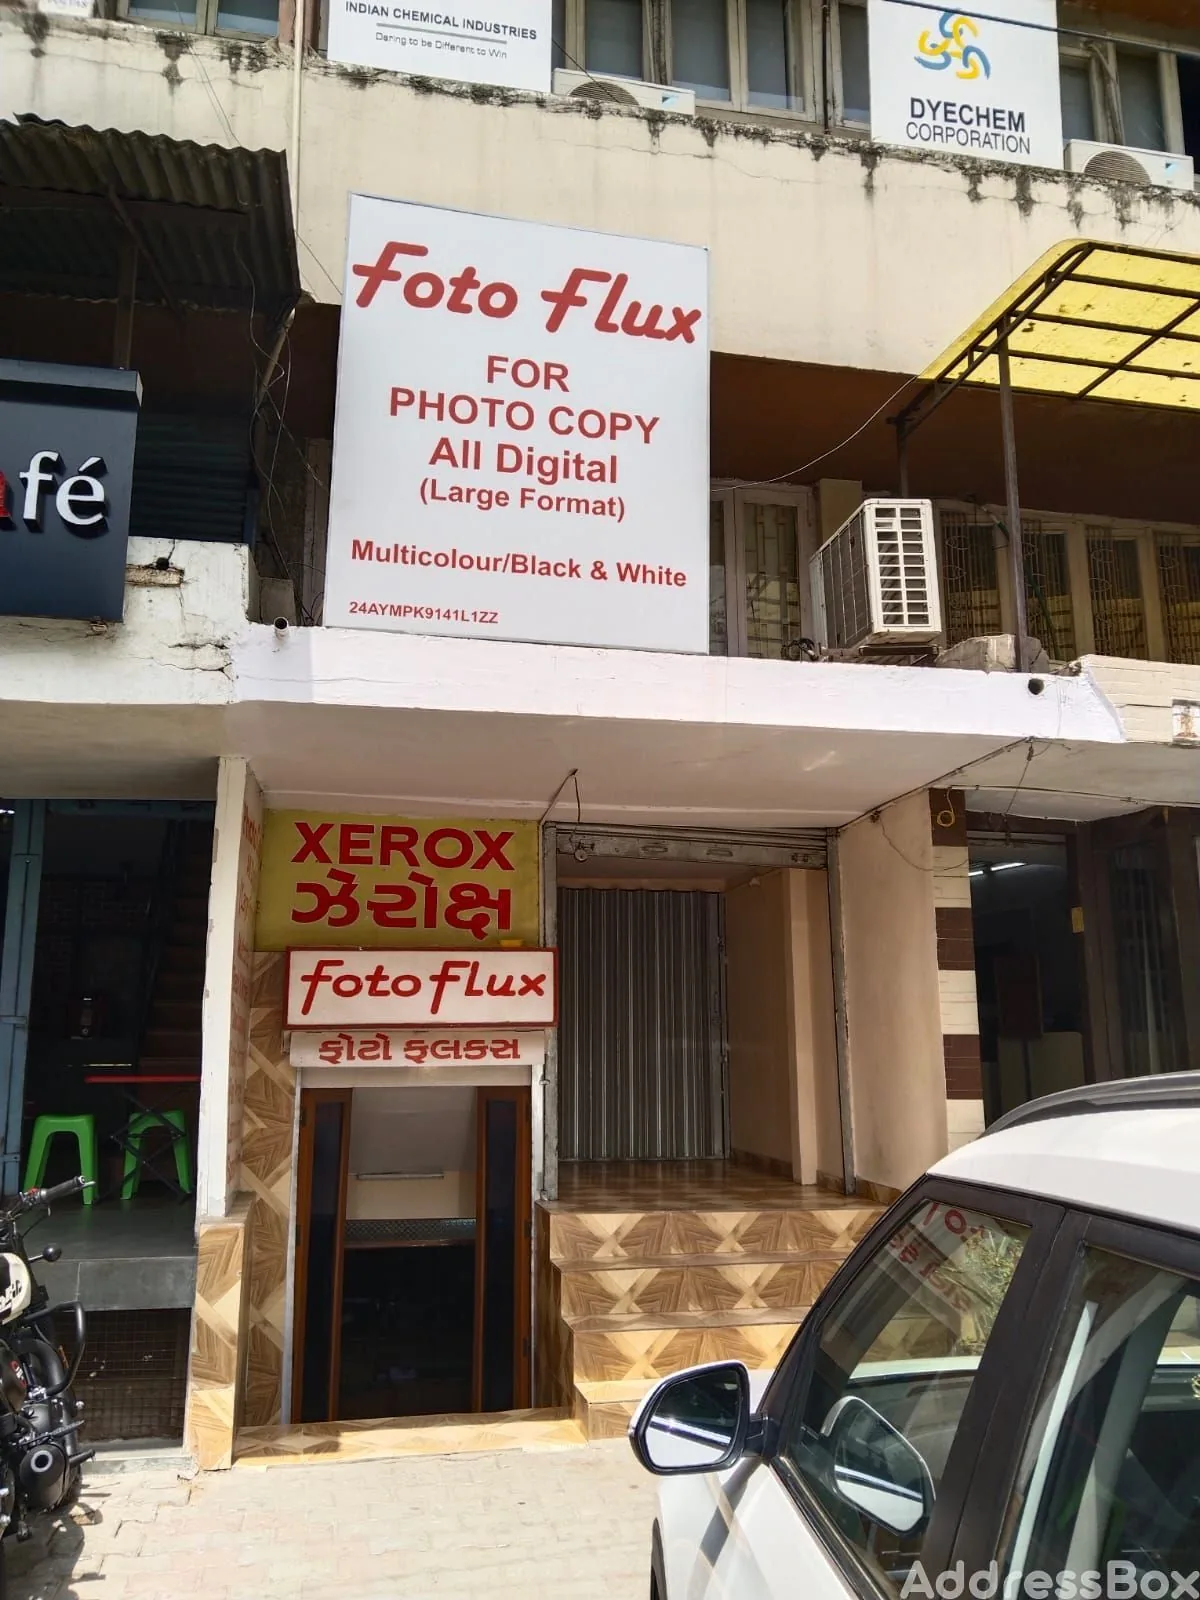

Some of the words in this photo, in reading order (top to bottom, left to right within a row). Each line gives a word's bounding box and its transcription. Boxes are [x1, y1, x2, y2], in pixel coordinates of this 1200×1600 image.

[345, 1, 390, 17] INDIAN
[393, 8, 460, 28] CHEMICAL
[462, 18, 538, 41] INDUSTRIES
[375, 32, 407, 47] Daring
[409, 38, 419, 47] to
[421, 39, 433, 49] be
[435, 40, 475, 55] Different
[477, 46, 487, 57] to
[488, 48, 508, 60] Win
[910, 96, 1026, 133] DYECHEM
[906, 121, 1031, 155] CORPORATION
[352, 241, 519, 319] Foto
[541, 267, 702, 344] Flux
[486, 354, 570, 393] FOR
[389, 386, 535, 431] PHOTO
[548, 405, 660, 445] COPY
[428, 437, 482, 470] All
[496, 443, 618, 486] Digital
[0, 449, 106, 526] fé
[419, 477, 511, 512] (Large
[519, 486, 626, 523] Format)
[351, 538, 582, 579] Multicolour/Black
[590, 560, 609, 581] &
[616, 561, 688, 588] White
[349, 600, 500, 625] 24AYMPK9141L1ZZ
[290, 821, 516, 871] XEROX
[290, 867, 512, 941] ઝેરોક્ષ
[318, 1032, 393, 1065] ફોટો
